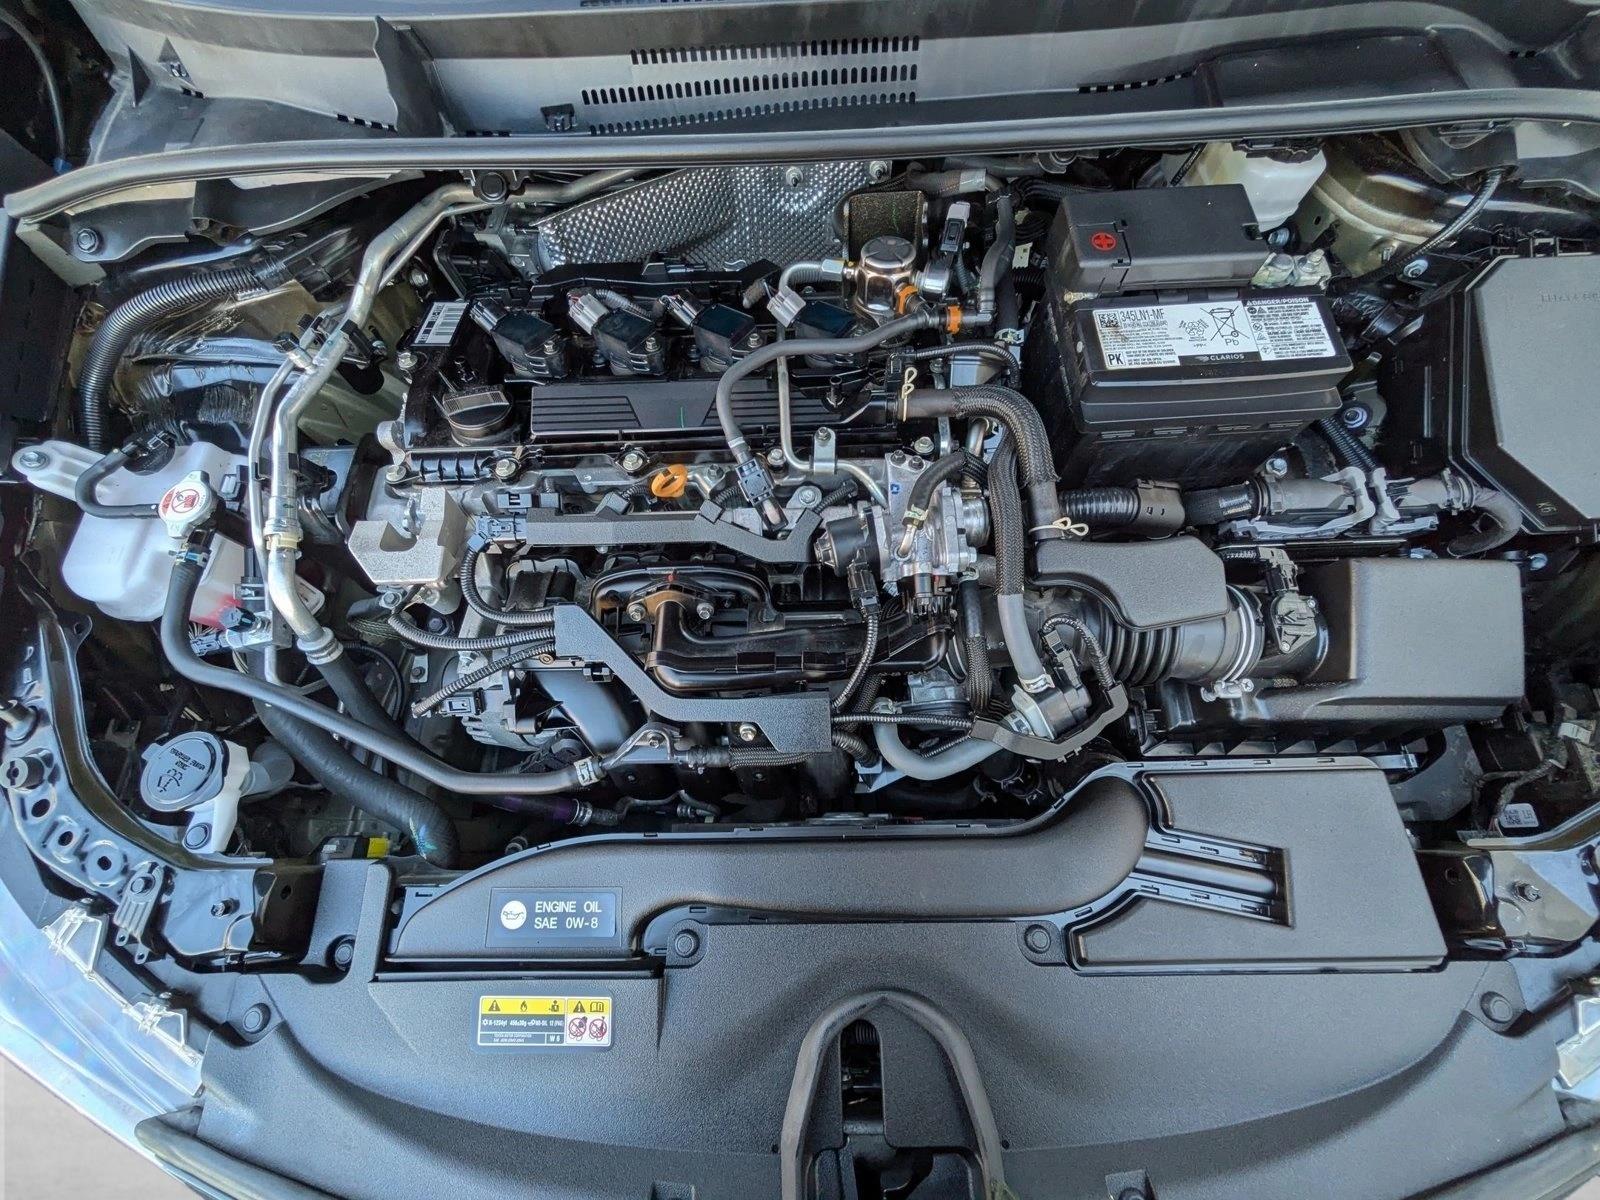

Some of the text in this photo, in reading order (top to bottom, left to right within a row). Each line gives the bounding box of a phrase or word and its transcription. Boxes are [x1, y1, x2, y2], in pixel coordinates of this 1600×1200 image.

[1252, 297, 1309, 305] DANGER/POISON
[1120, 308, 1165, 322] 345LN1-MF
[1224, 338, 1240, 346] Pb
[1107, 353, 1124, 366] PK
[1210, 353, 1245, 361] CLARIOS
[535, 901, 602, 913] ENGINE OIL
[534, 917, 598, 929] SAE 0W-8
